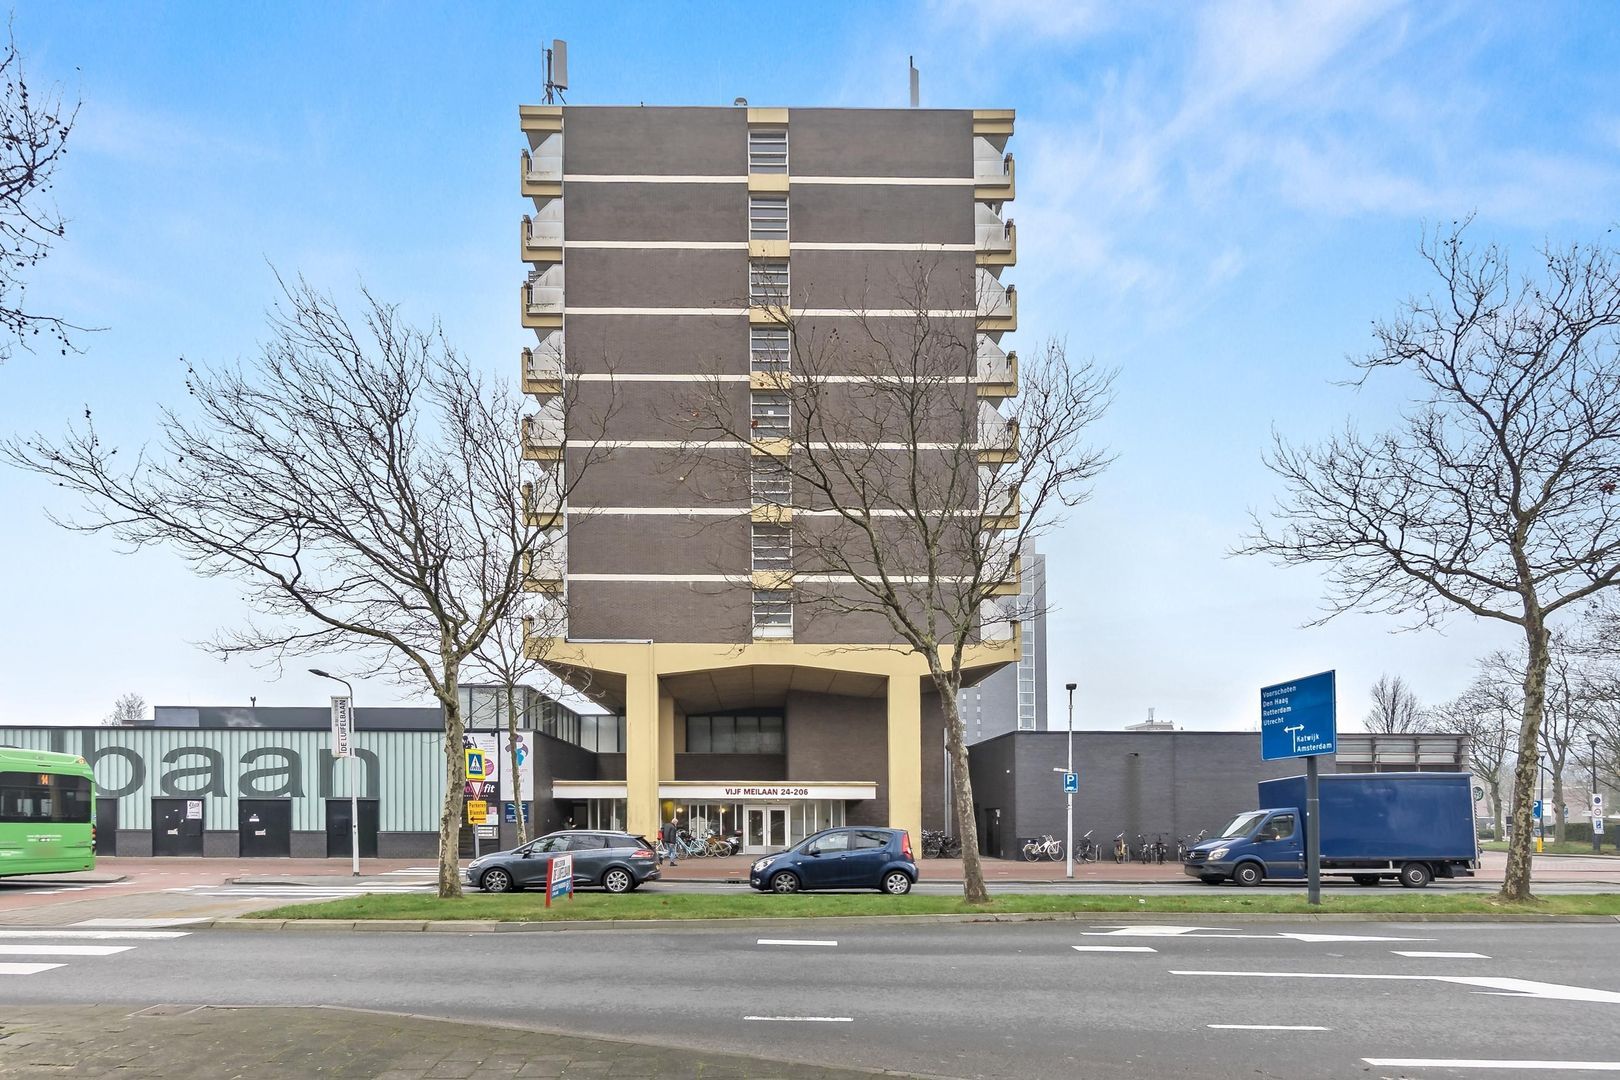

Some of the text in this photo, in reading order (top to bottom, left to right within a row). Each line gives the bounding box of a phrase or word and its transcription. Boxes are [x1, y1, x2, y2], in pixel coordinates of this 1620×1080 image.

[1262, 686, 1297, 698] Voorschoten
[1263, 706, 1292, 717] Rotterdam
[1263, 717, 1284, 726] Utrecht
[1296, 734, 1320, 742] Katwijk
[1296, 743, 1333, 753] Amsterdam
[1066, 775, 1075, 785] P
[725, 788, 809, 796] VIJF MEILAAN 24-206
